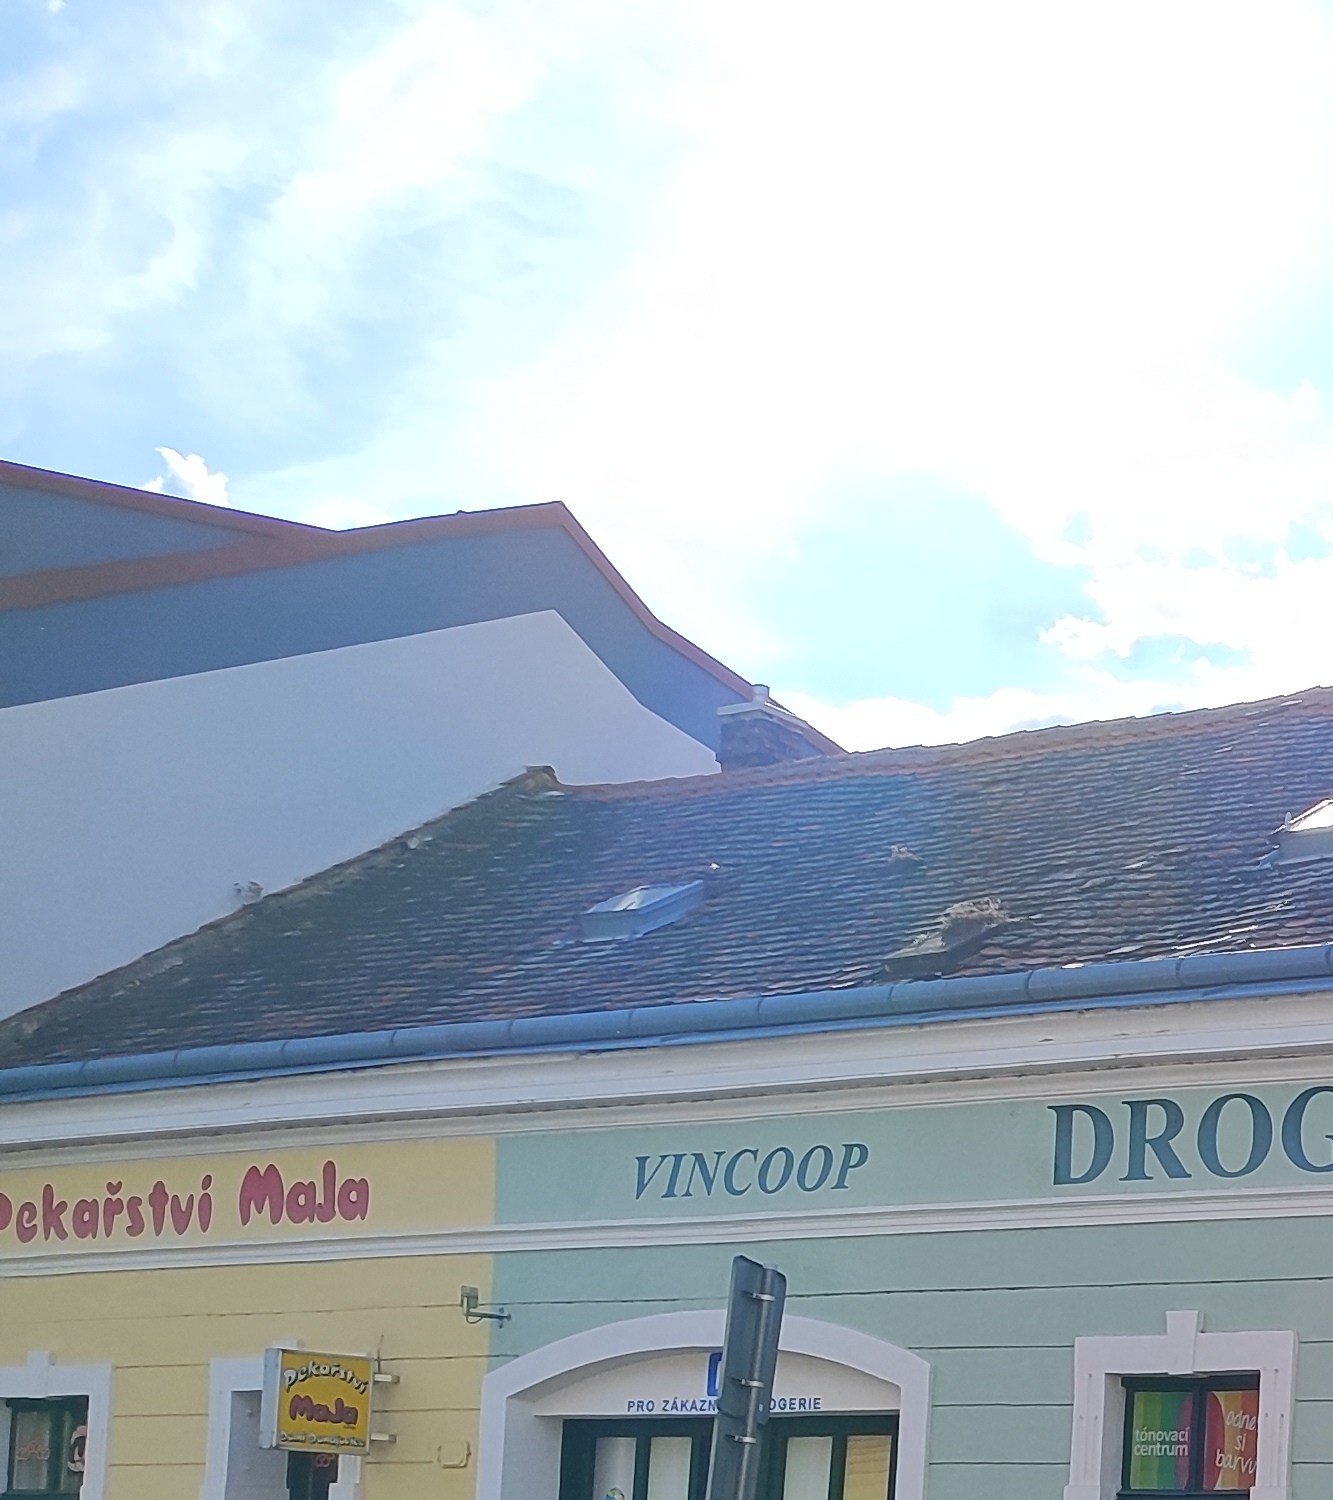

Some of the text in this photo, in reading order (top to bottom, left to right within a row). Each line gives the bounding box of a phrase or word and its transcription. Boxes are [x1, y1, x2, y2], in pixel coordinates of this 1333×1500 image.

[634, 1143, 870, 1201] VINCOOP
[283, 1360, 369, 1396] Pekařství
[627, 1399, 655, 1413] PRO
[661, 1396, 718, 1413] ZÁKAZN
[1226, 1410, 1257, 1431] odne
[1135, 1427, 1191, 1442] tónovací
[1234, 1432, 1247, 1452] si
[1134, 1442, 1189, 1457] centrum
